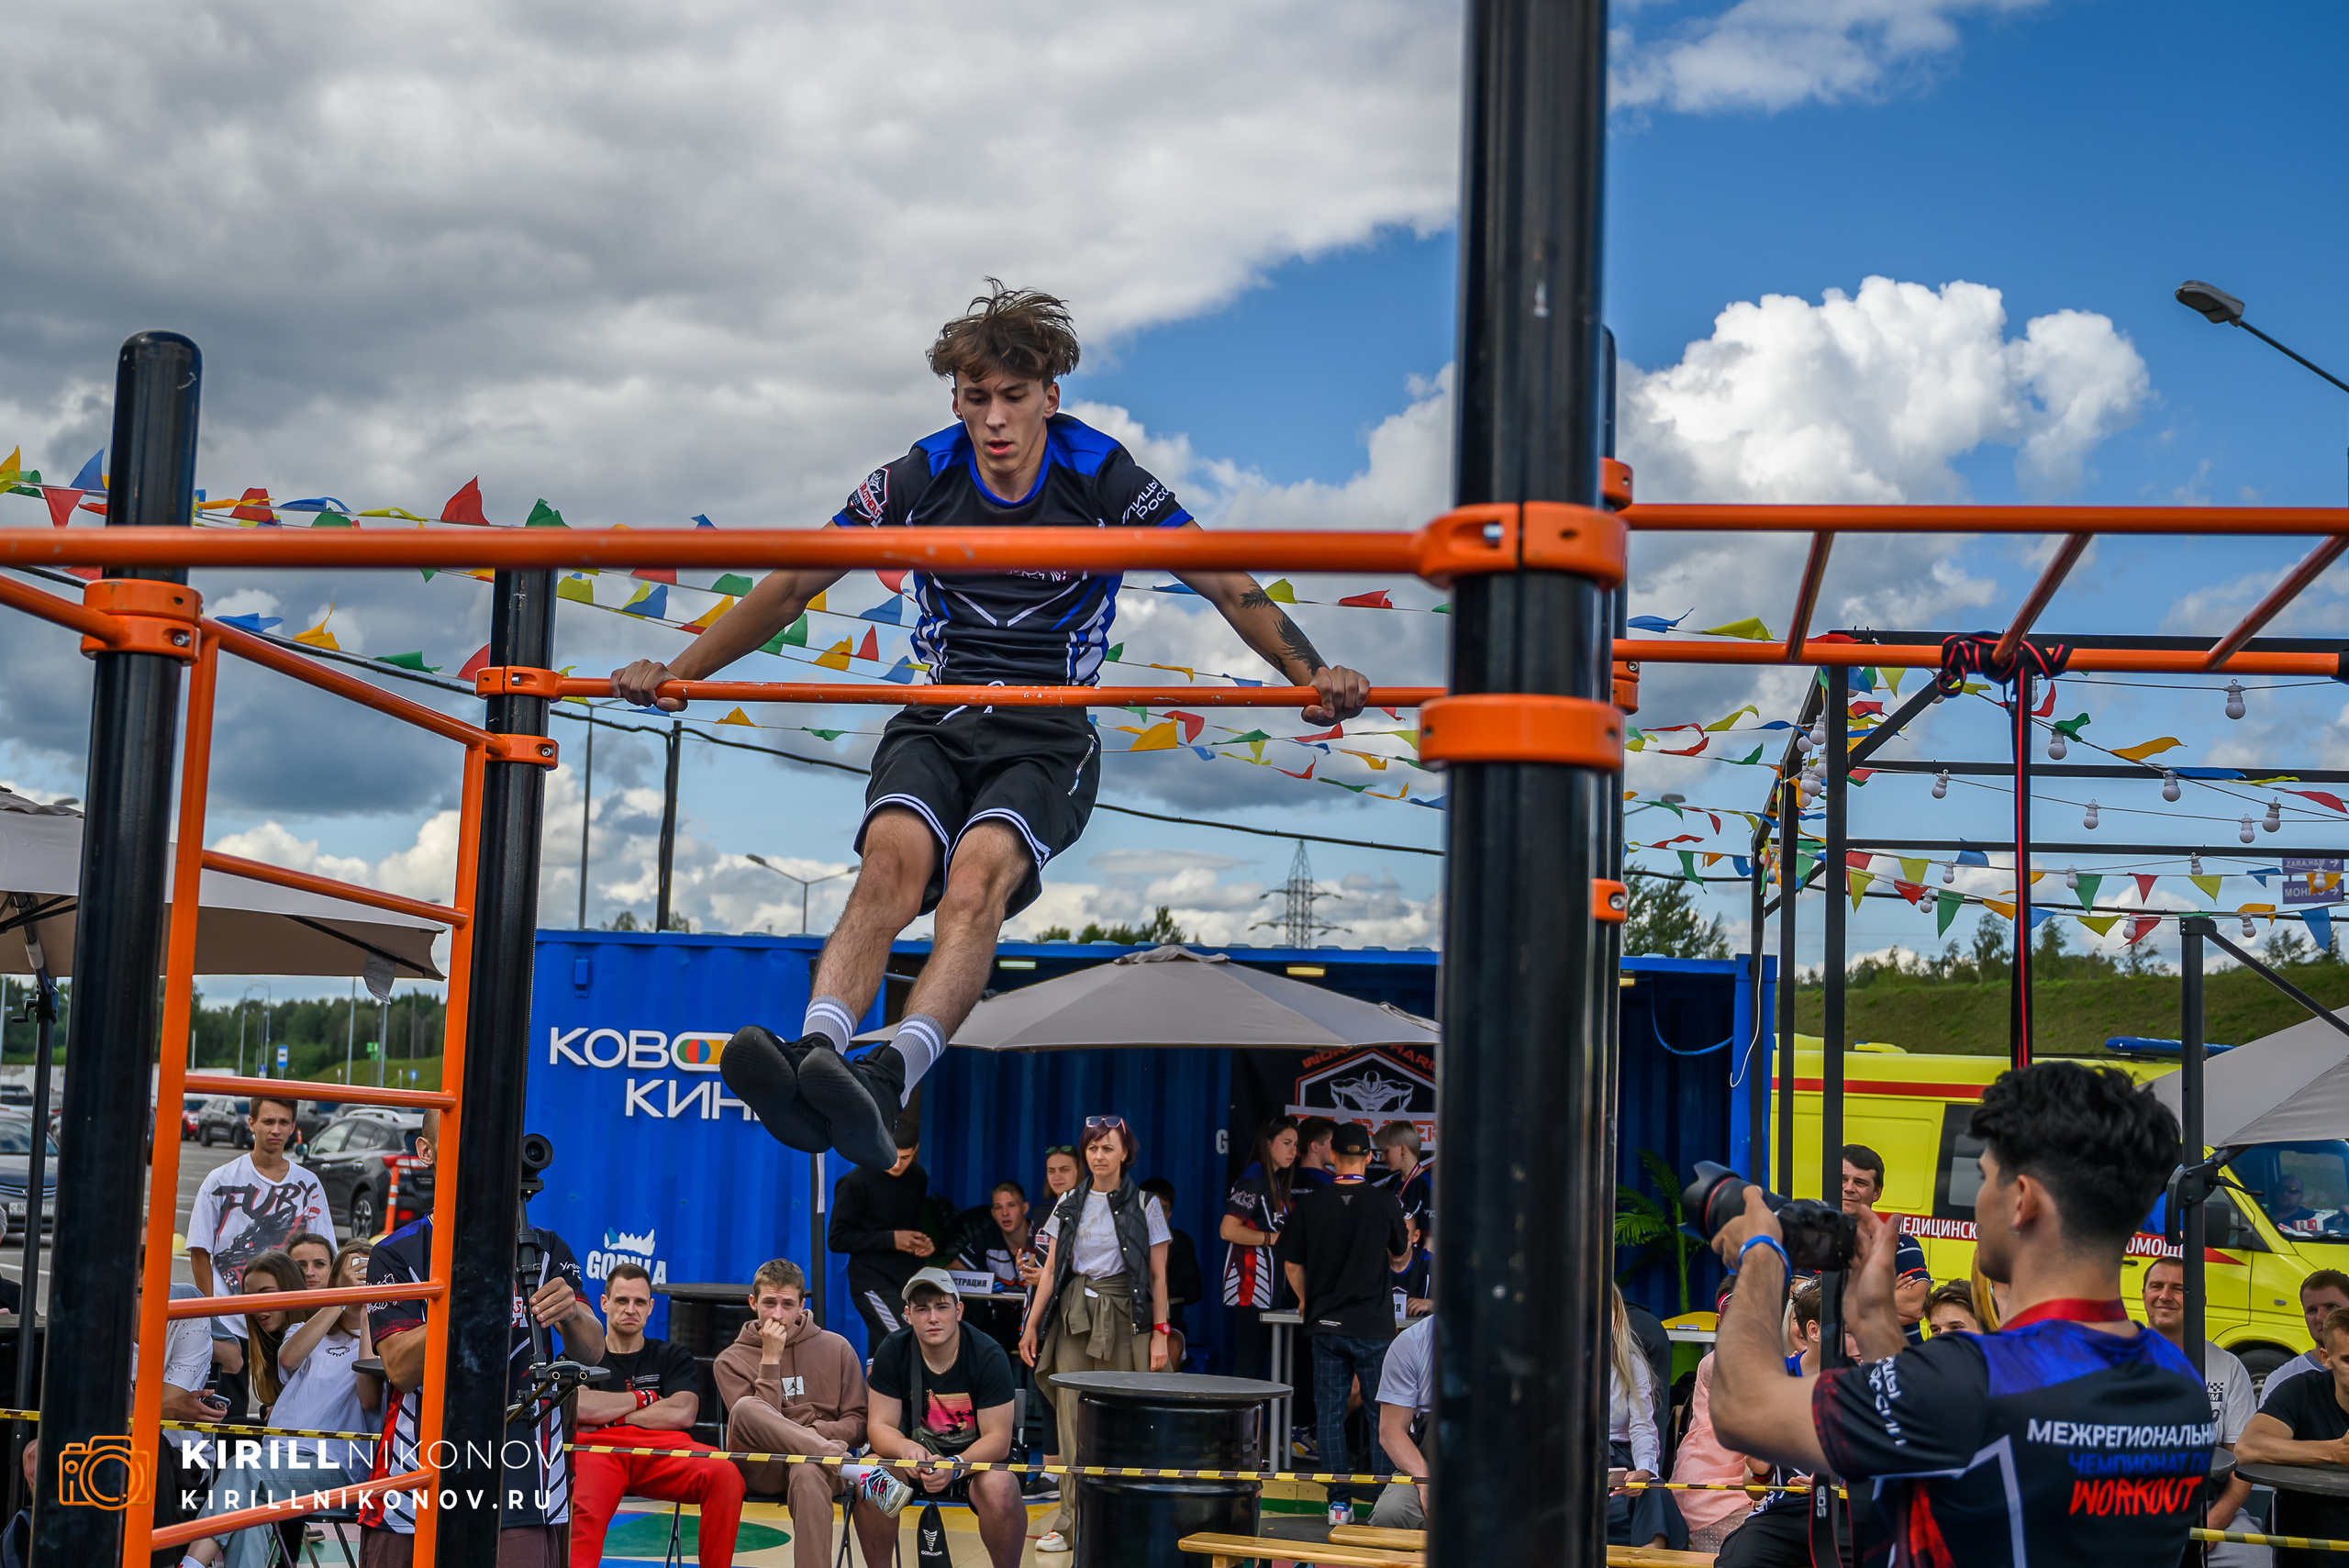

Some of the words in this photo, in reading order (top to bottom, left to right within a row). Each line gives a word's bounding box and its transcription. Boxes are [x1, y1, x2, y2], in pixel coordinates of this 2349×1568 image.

[626, 1078, 761, 1121] КИН
[211, 1180, 318, 1224] FURY
[1898, 1217, 1978, 1240] ЕДИЦИНСК
[2068, 1451, 2188, 1474] ЧЕМПИОНАТ
[1817, 1485, 1827, 1518] EOS
[2069, 1475, 2203, 1516] WORKOUT
